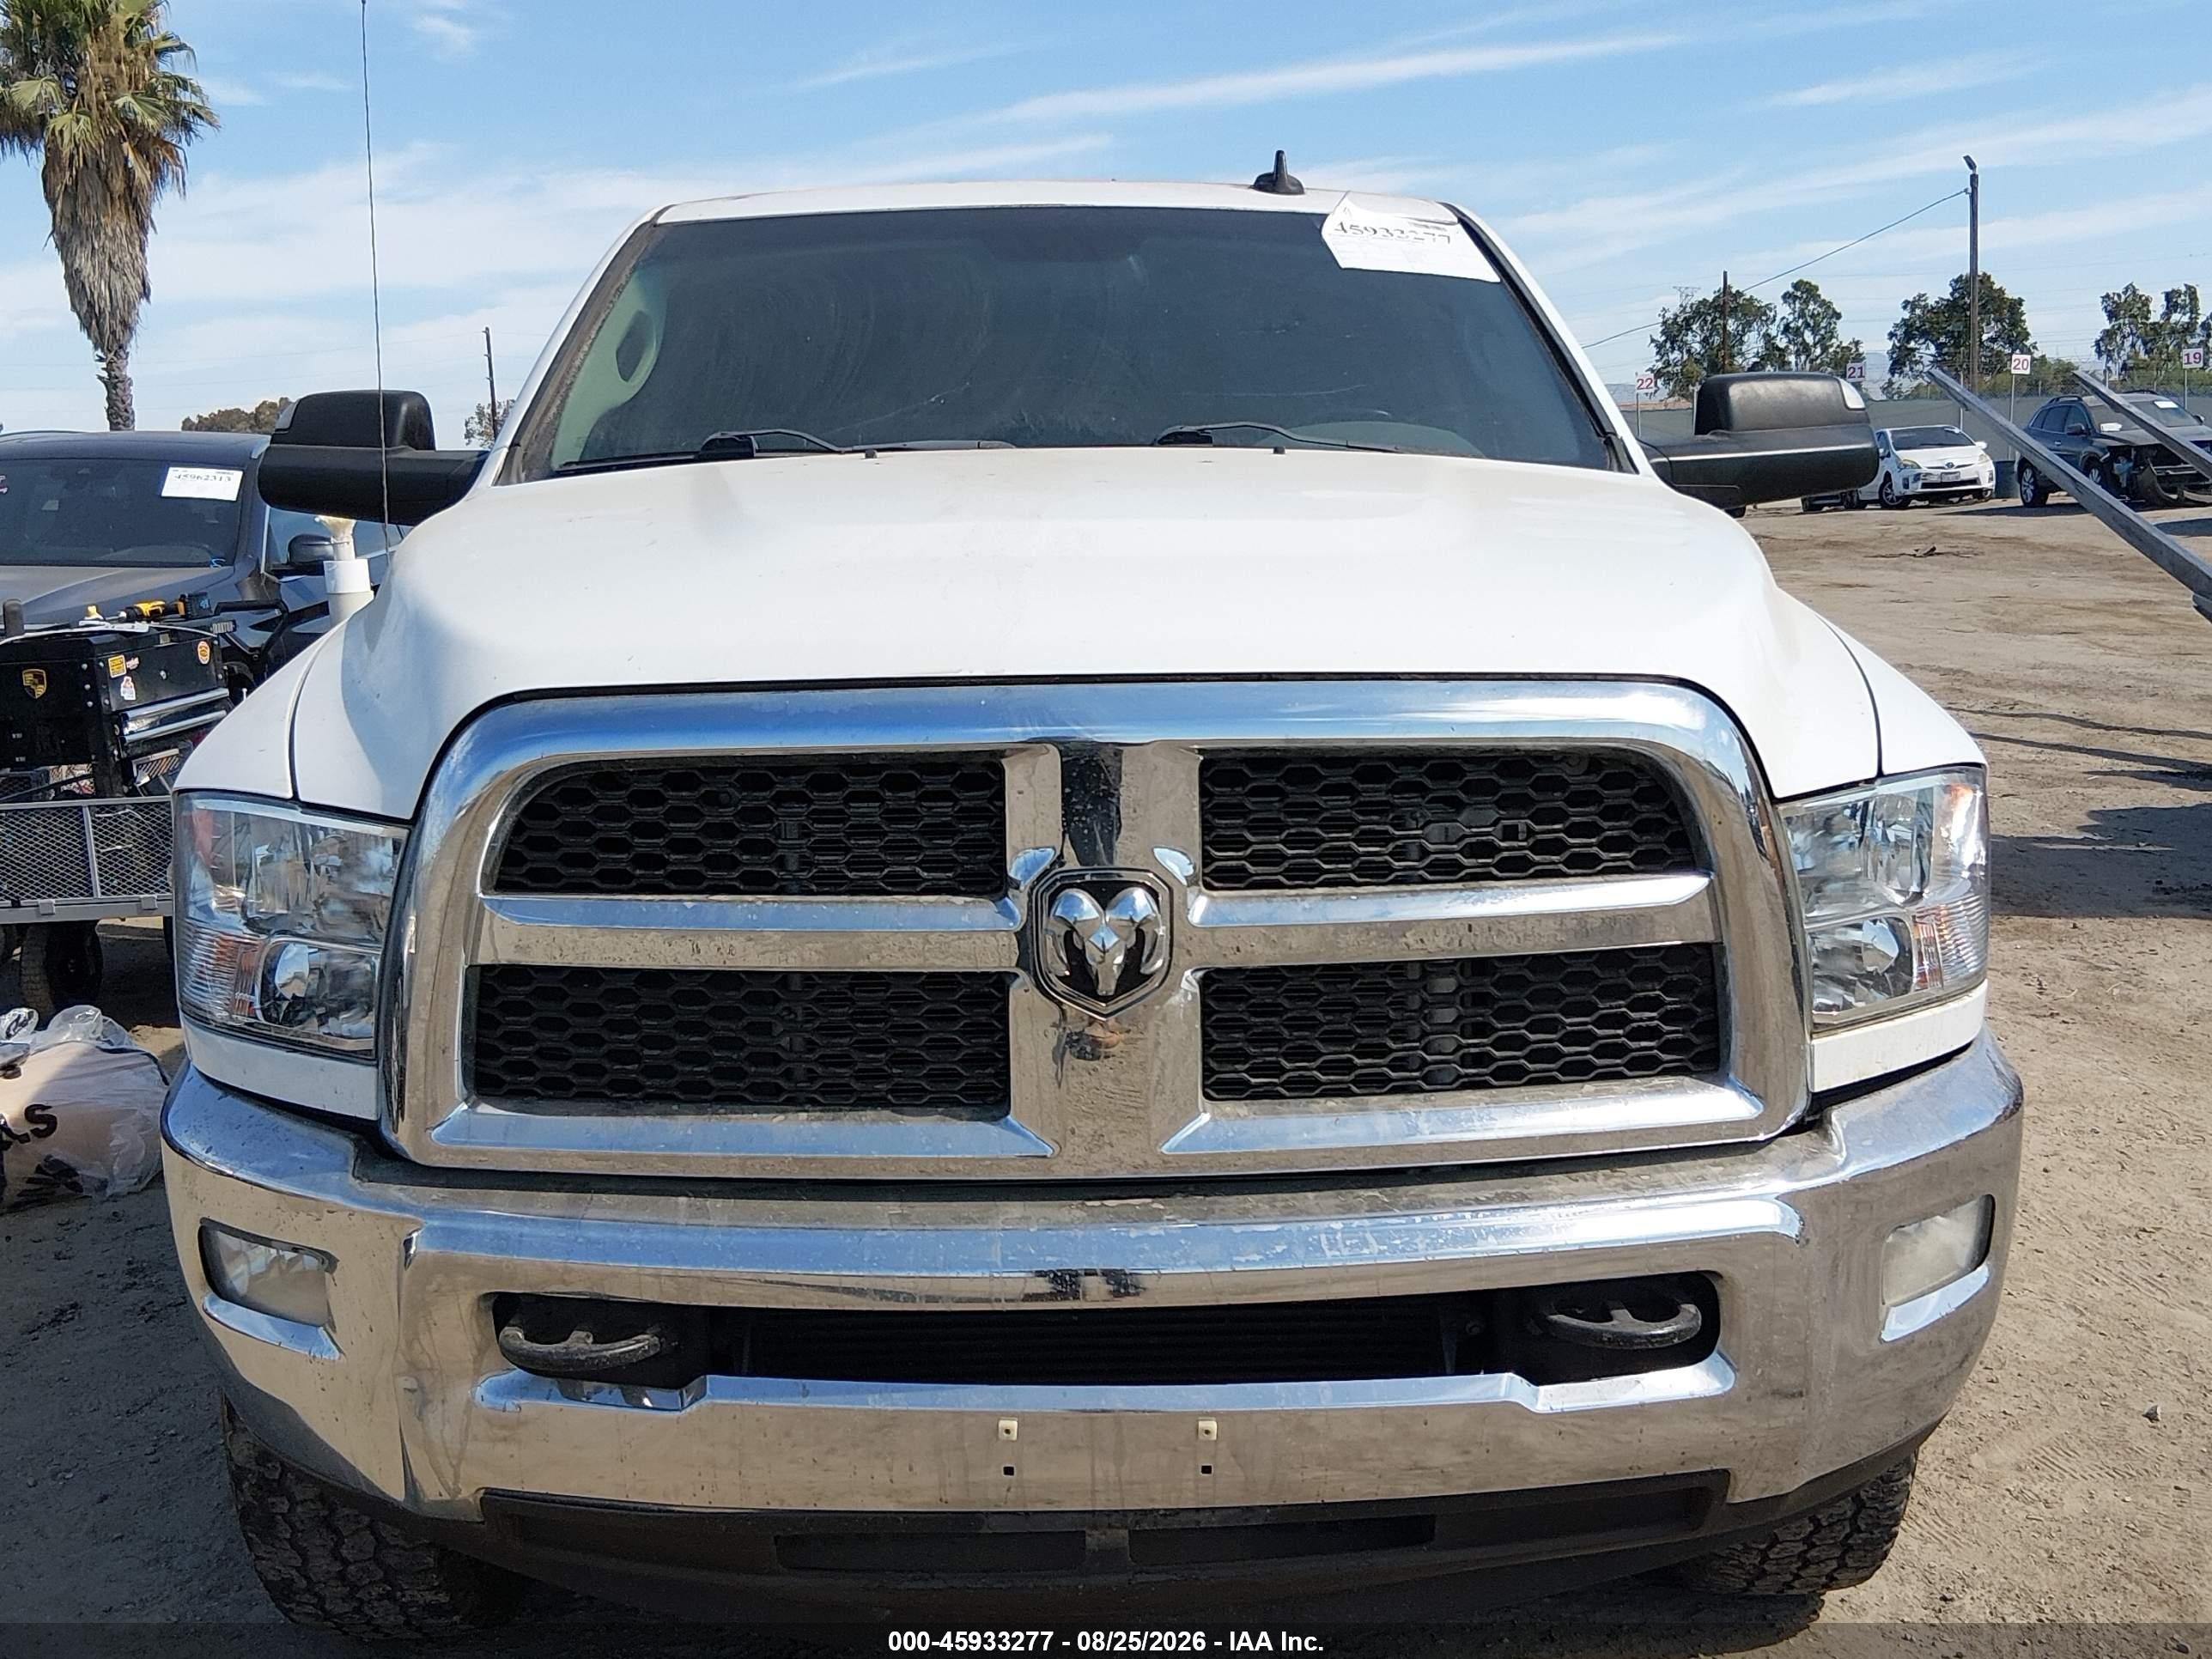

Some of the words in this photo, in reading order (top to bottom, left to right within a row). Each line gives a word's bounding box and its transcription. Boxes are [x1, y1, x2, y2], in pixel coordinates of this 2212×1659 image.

[2012, 358, 2029, 371] 20
[2184, 351, 2202, 365] 19
[1847, 366, 1865, 380] 21
[1636, 378, 1654, 391] 22
